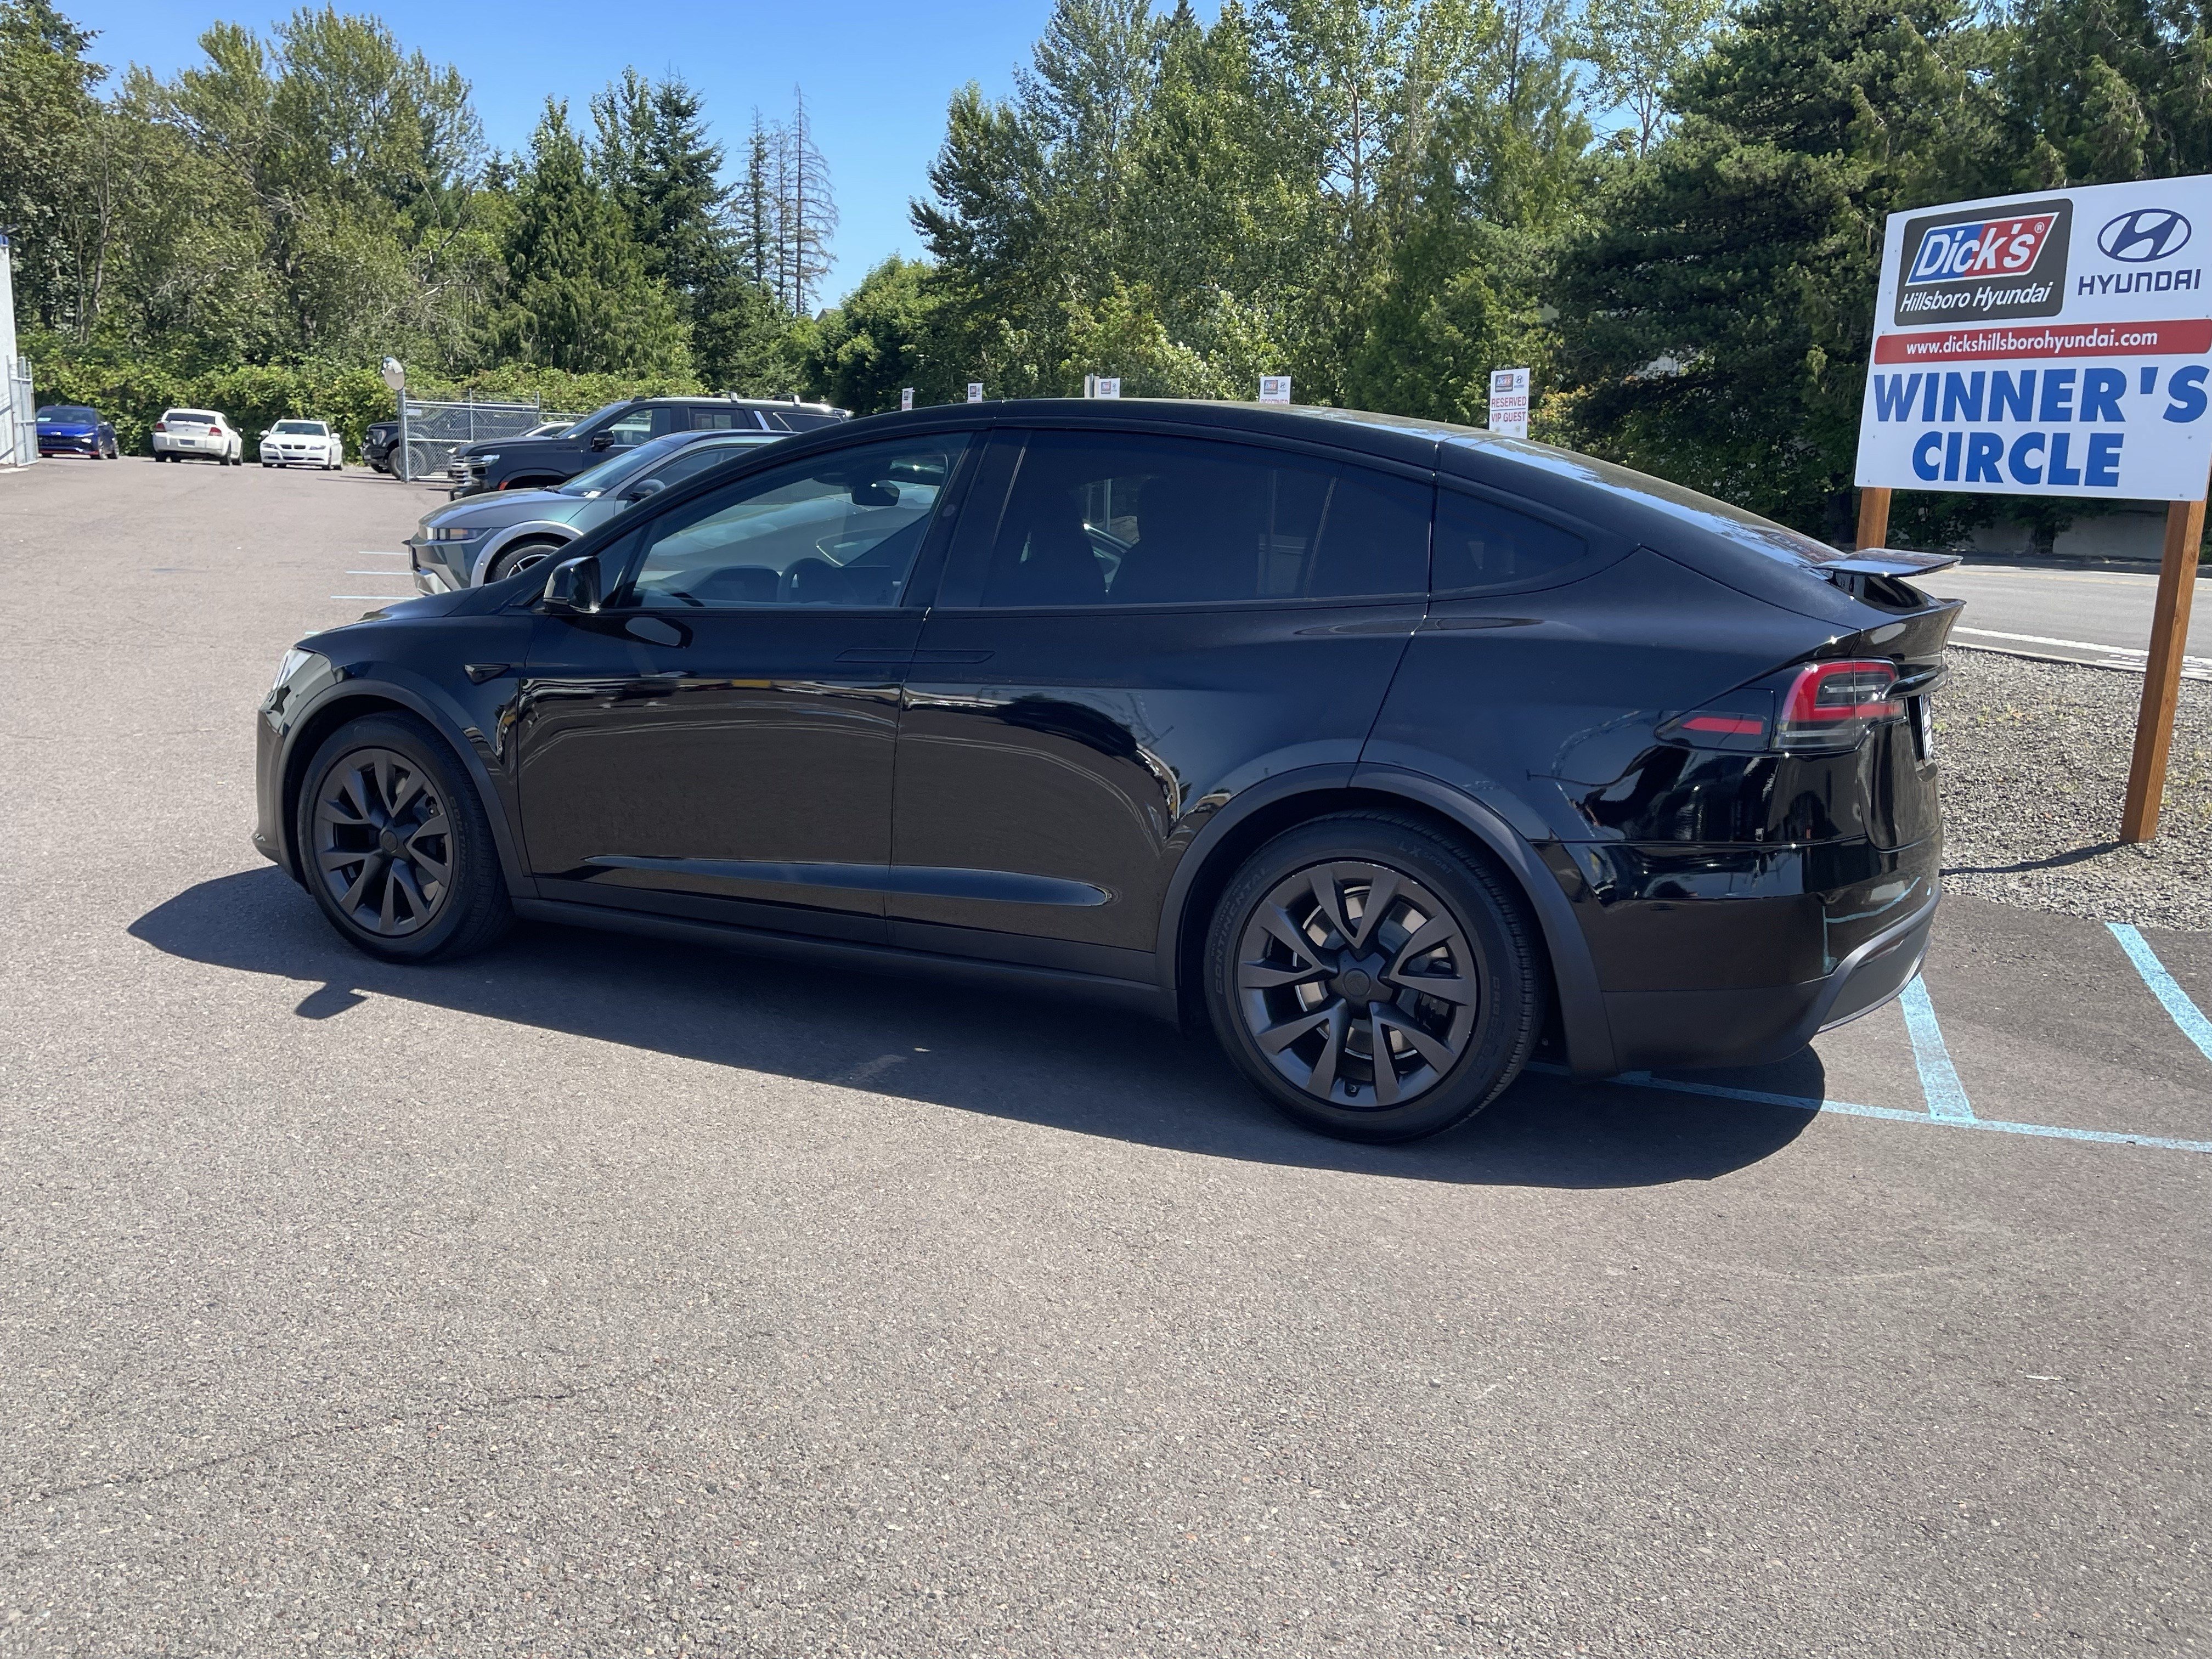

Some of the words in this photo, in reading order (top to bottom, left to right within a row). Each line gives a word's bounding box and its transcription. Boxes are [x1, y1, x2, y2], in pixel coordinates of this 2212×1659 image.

[1915, 223, 2035, 277] Dick's
[1899, 290, 1971, 313] Hillsboro
[1972, 281, 2054, 312] Hyundai
[2077, 268, 2202, 296] HYUNDAI
[1906, 328, 2158, 355] www.dickshillsborohyundai.com
[1492, 396, 1527, 408] RESERVED
[1873, 365, 2210, 424] WINNER'S
[1492, 413, 1502, 423] VIP
[1503, 411, 1526, 422] GUEST
[1912, 431, 2125, 487] CIRCLE
